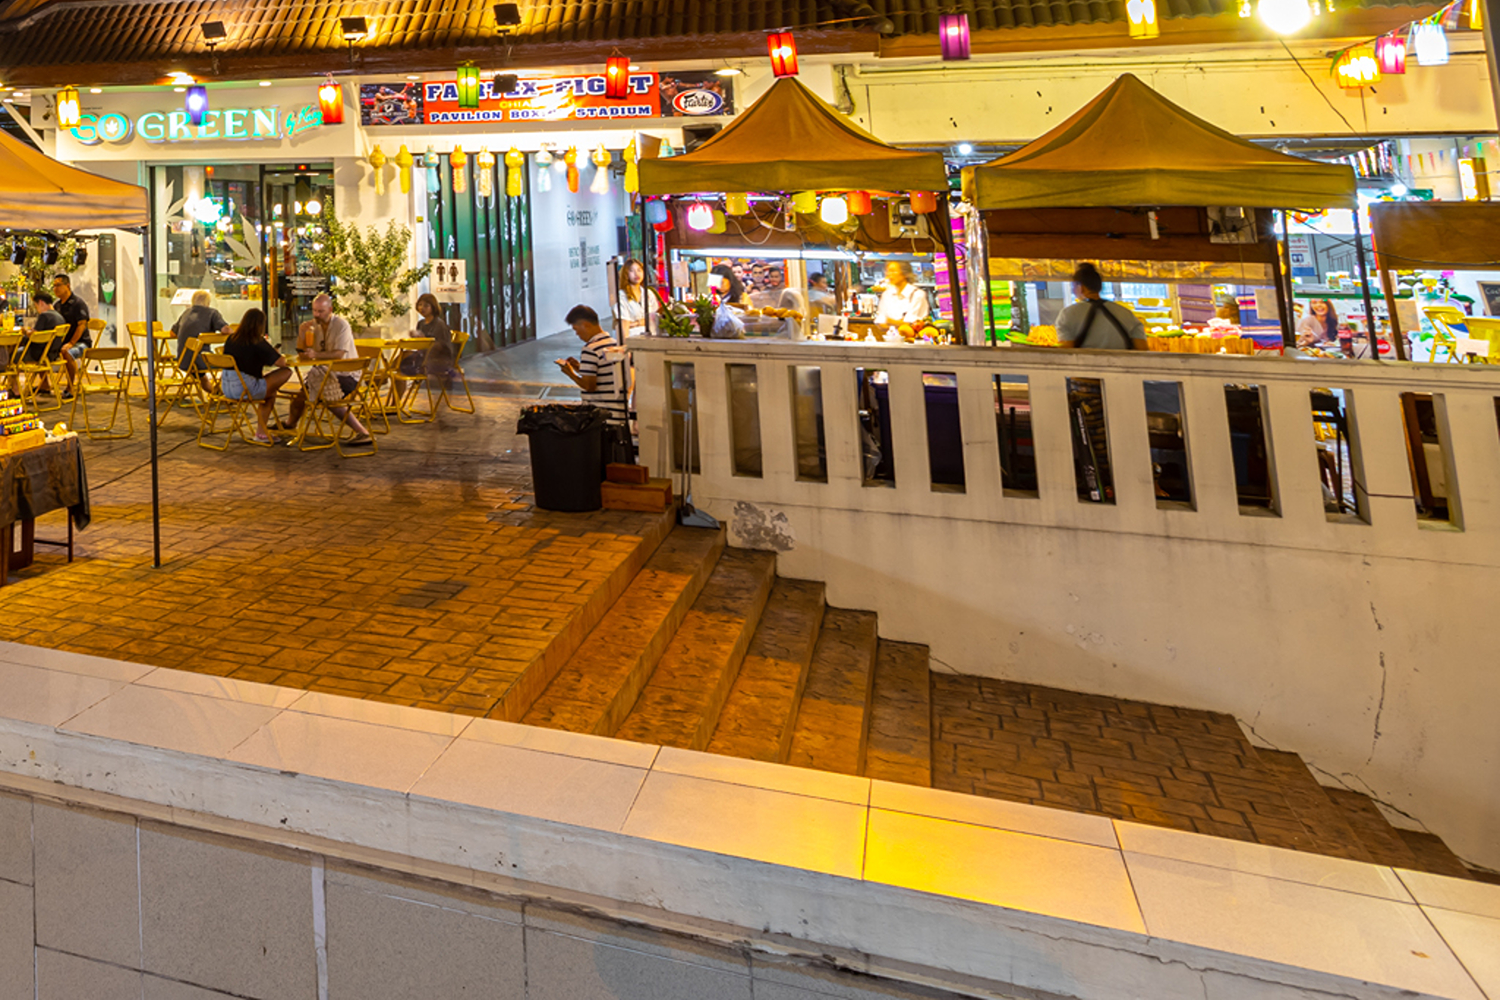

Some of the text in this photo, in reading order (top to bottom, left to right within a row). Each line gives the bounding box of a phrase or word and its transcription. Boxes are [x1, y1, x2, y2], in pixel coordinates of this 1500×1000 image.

[426, 76, 652, 100] FARTEX FIGT
[69, 113, 128, 142] GO
[137, 107, 278, 140] GREEN
[430, 111, 502, 122] PAVILION
[576, 105, 651, 116] STADIUM
